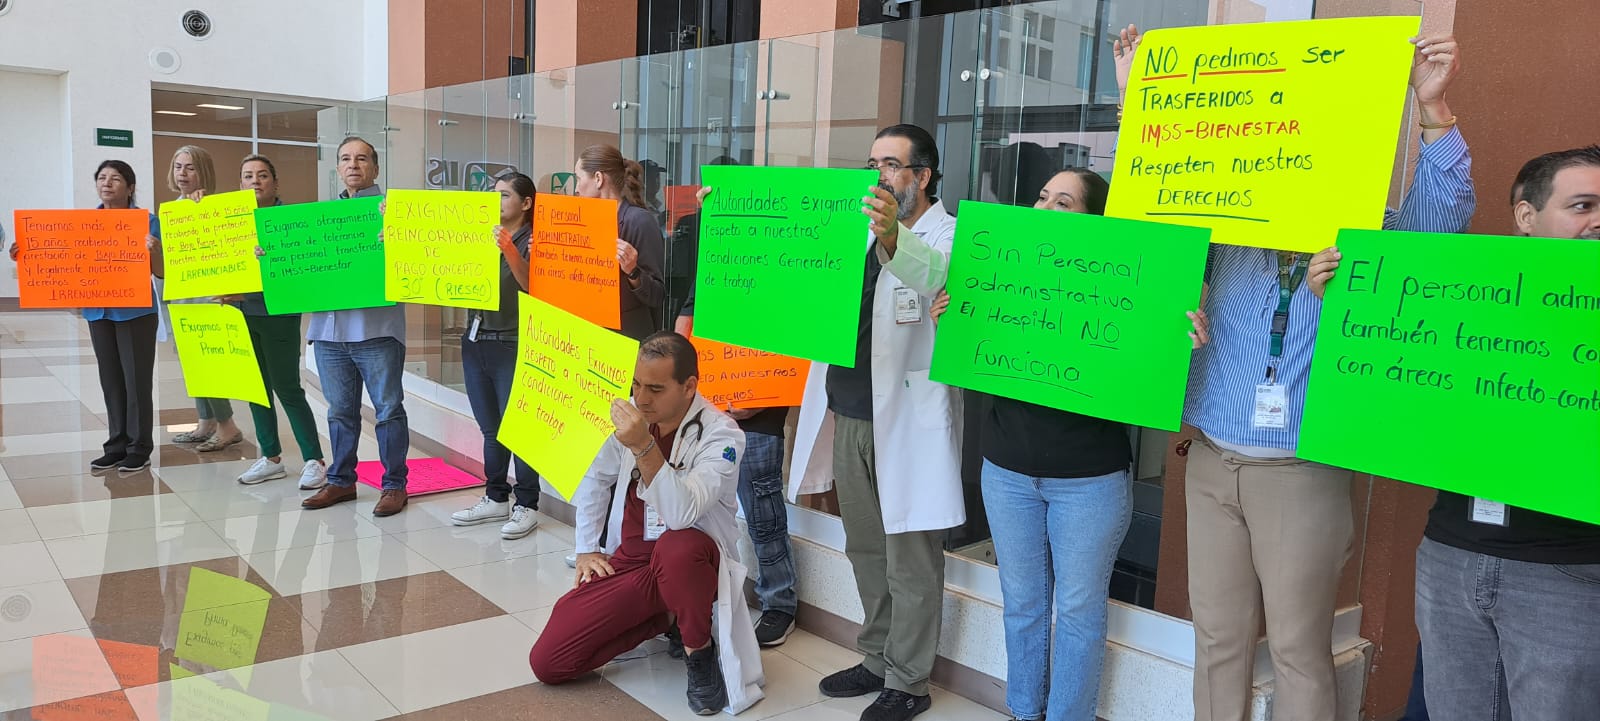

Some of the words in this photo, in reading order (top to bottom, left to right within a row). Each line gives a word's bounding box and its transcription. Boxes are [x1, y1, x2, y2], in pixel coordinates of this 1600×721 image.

[1144, 46, 1178, 76] NO
[1192, 47, 1279, 84] pedimos
[1139, 86, 1254, 112] TRASFERIDOS
[1270, 91, 1284, 105] a
[1141, 119, 1301, 148] IMSS-BIENESTAR
[1130, 155, 1215, 184] Respeten
[1231, 146, 1313, 174] nuestros
[711, 186, 789, 212] Autoridades
[1157, 188, 1253, 208] DERECHOS
[213, 210, 220, 218] de
[395, 201, 490, 225] EXIGIMOS
[551, 206, 582, 226] personal
[82, 219, 104, 232] más
[114, 220, 132, 231] de
[202, 226, 210, 234] la
[264, 220, 310, 238] Exigimos
[386, 225, 494, 244] REINCORPORACI
[705, 223, 741, 245] respeto
[748, 226, 757, 237] a
[764, 223, 821, 240] nuestras
[26, 237, 40, 249] 15
[126, 236, 138, 246] la
[266, 242, 275, 251] de
[280, 240, 300, 250] hora
[306, 236, 317, 246] de
[324, 231, 366, 242] tolerancia
[74, 250, 87, 260] de
[270, 256, 286, 270] para
[290, 248, 327, 266] personal
[424, 246, 440, 258] DE
[778, 252, 843, 271] Generales
[969, 230, 1022, 264] Sin
[1036, 242, 1142, 287] Personal
[180, 260, 248, 282] IRRENUNCIABLES
[282, 260, 352, 278] IMSS-Bienestar
[394, 260, 427, 278] PAGO
[80, 278, 100, 287] son
[704, 272, 716, 286] de
[723, 273, 757, 295] trabajo
[965, 272, 1134, 312] administrativo
[1347, 255, 1385, 295] El
[1396, 272, 1524, 318] personal
[48, 288, 136, 301] IRRENUNCIABLES
[180, 318, 221, 338] Exigimos
[960, 301, 976, 318] El
[987, 307, 1064, 336] Hospital
[1081, 318, 1120, 344] NO
[526, 314, 581, 360] Autoridades
[1341, 308, 1438, 346] también
[1456, 322, 1551, 359] tenemos
[1572, 343, 1600, 365] co
[524, 344, 557, 373] RESPETO
[562, 368, 570, 381] a
[1386, 356, 1454, 391] áreas
[516, 393, 528, 413] de
